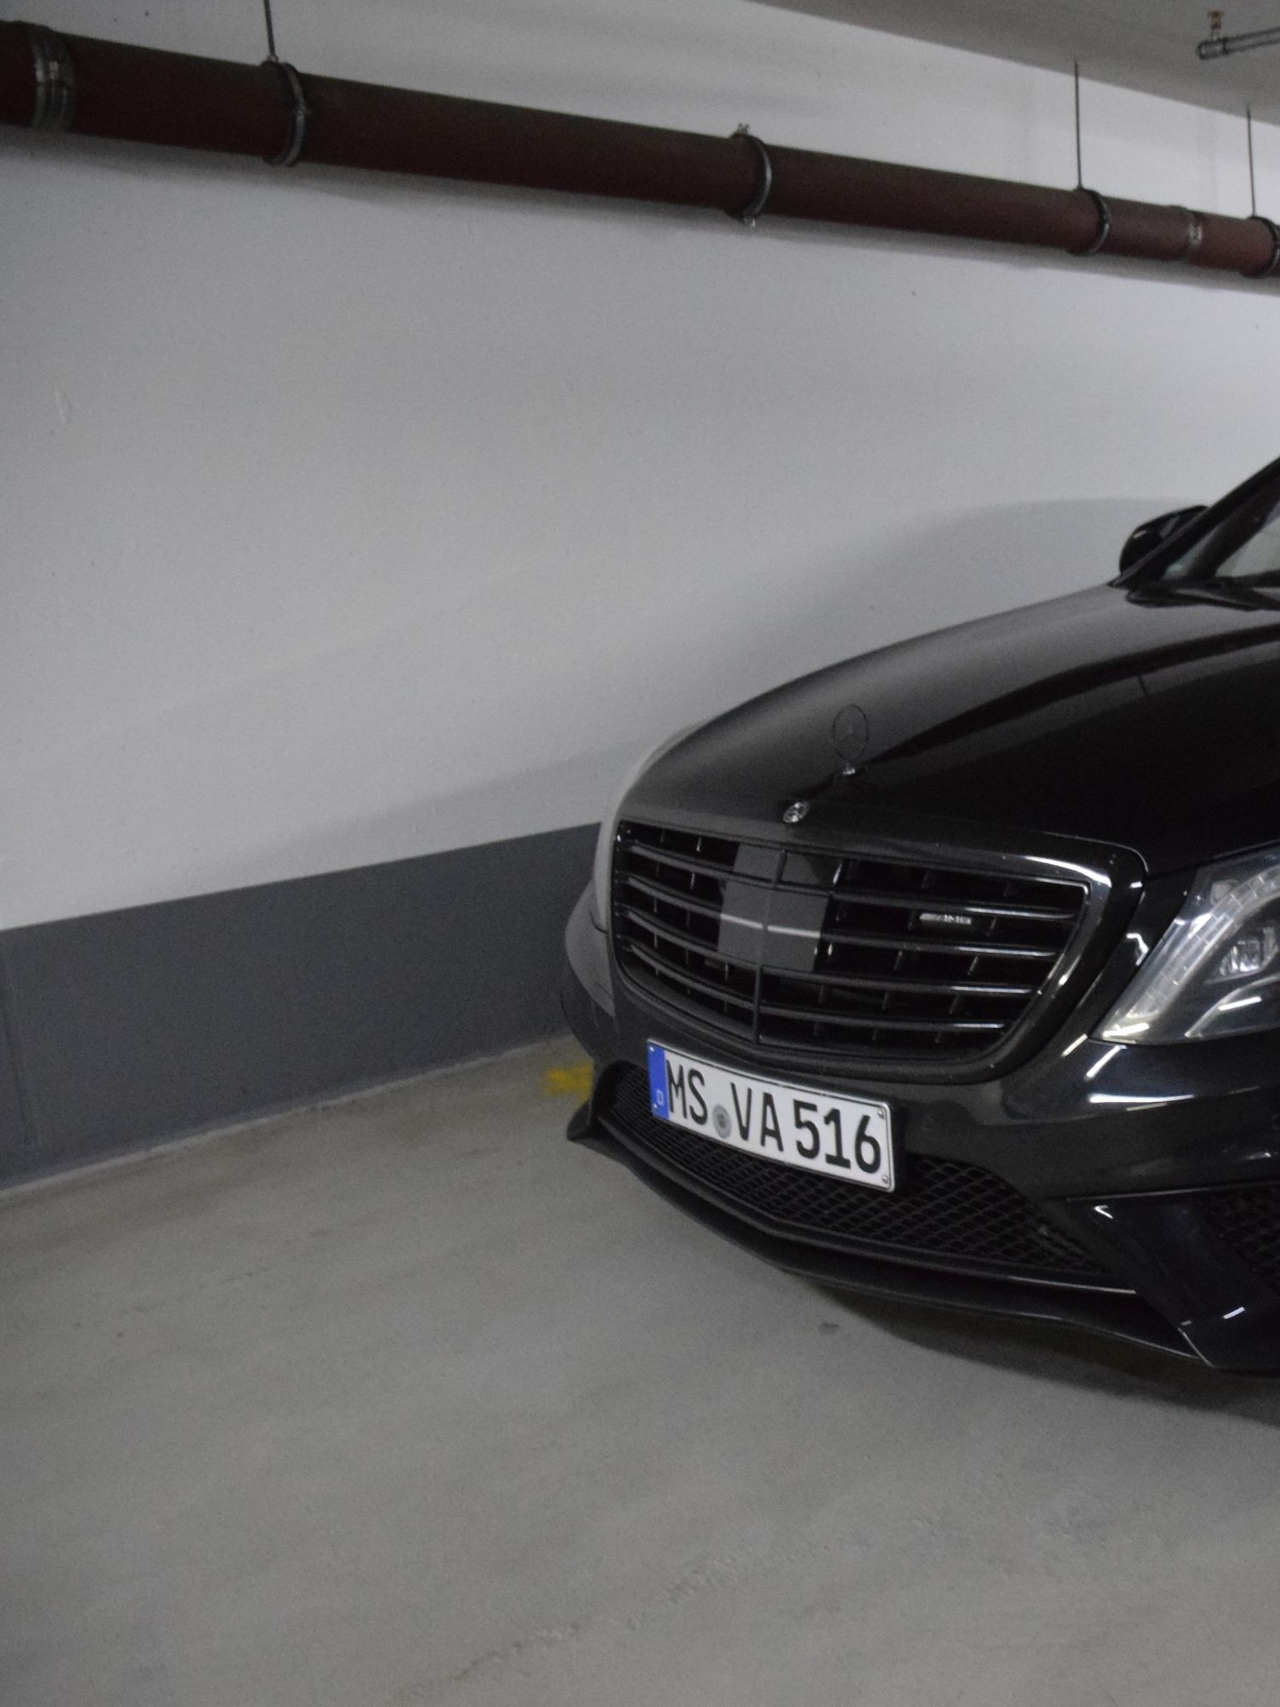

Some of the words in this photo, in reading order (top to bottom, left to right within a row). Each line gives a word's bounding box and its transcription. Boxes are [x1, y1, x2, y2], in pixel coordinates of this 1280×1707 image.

[666, 1059, 708, 1126] MS
[730, 1081, 784, 1152] VA
[793, 1099, 881, 1174] 516
